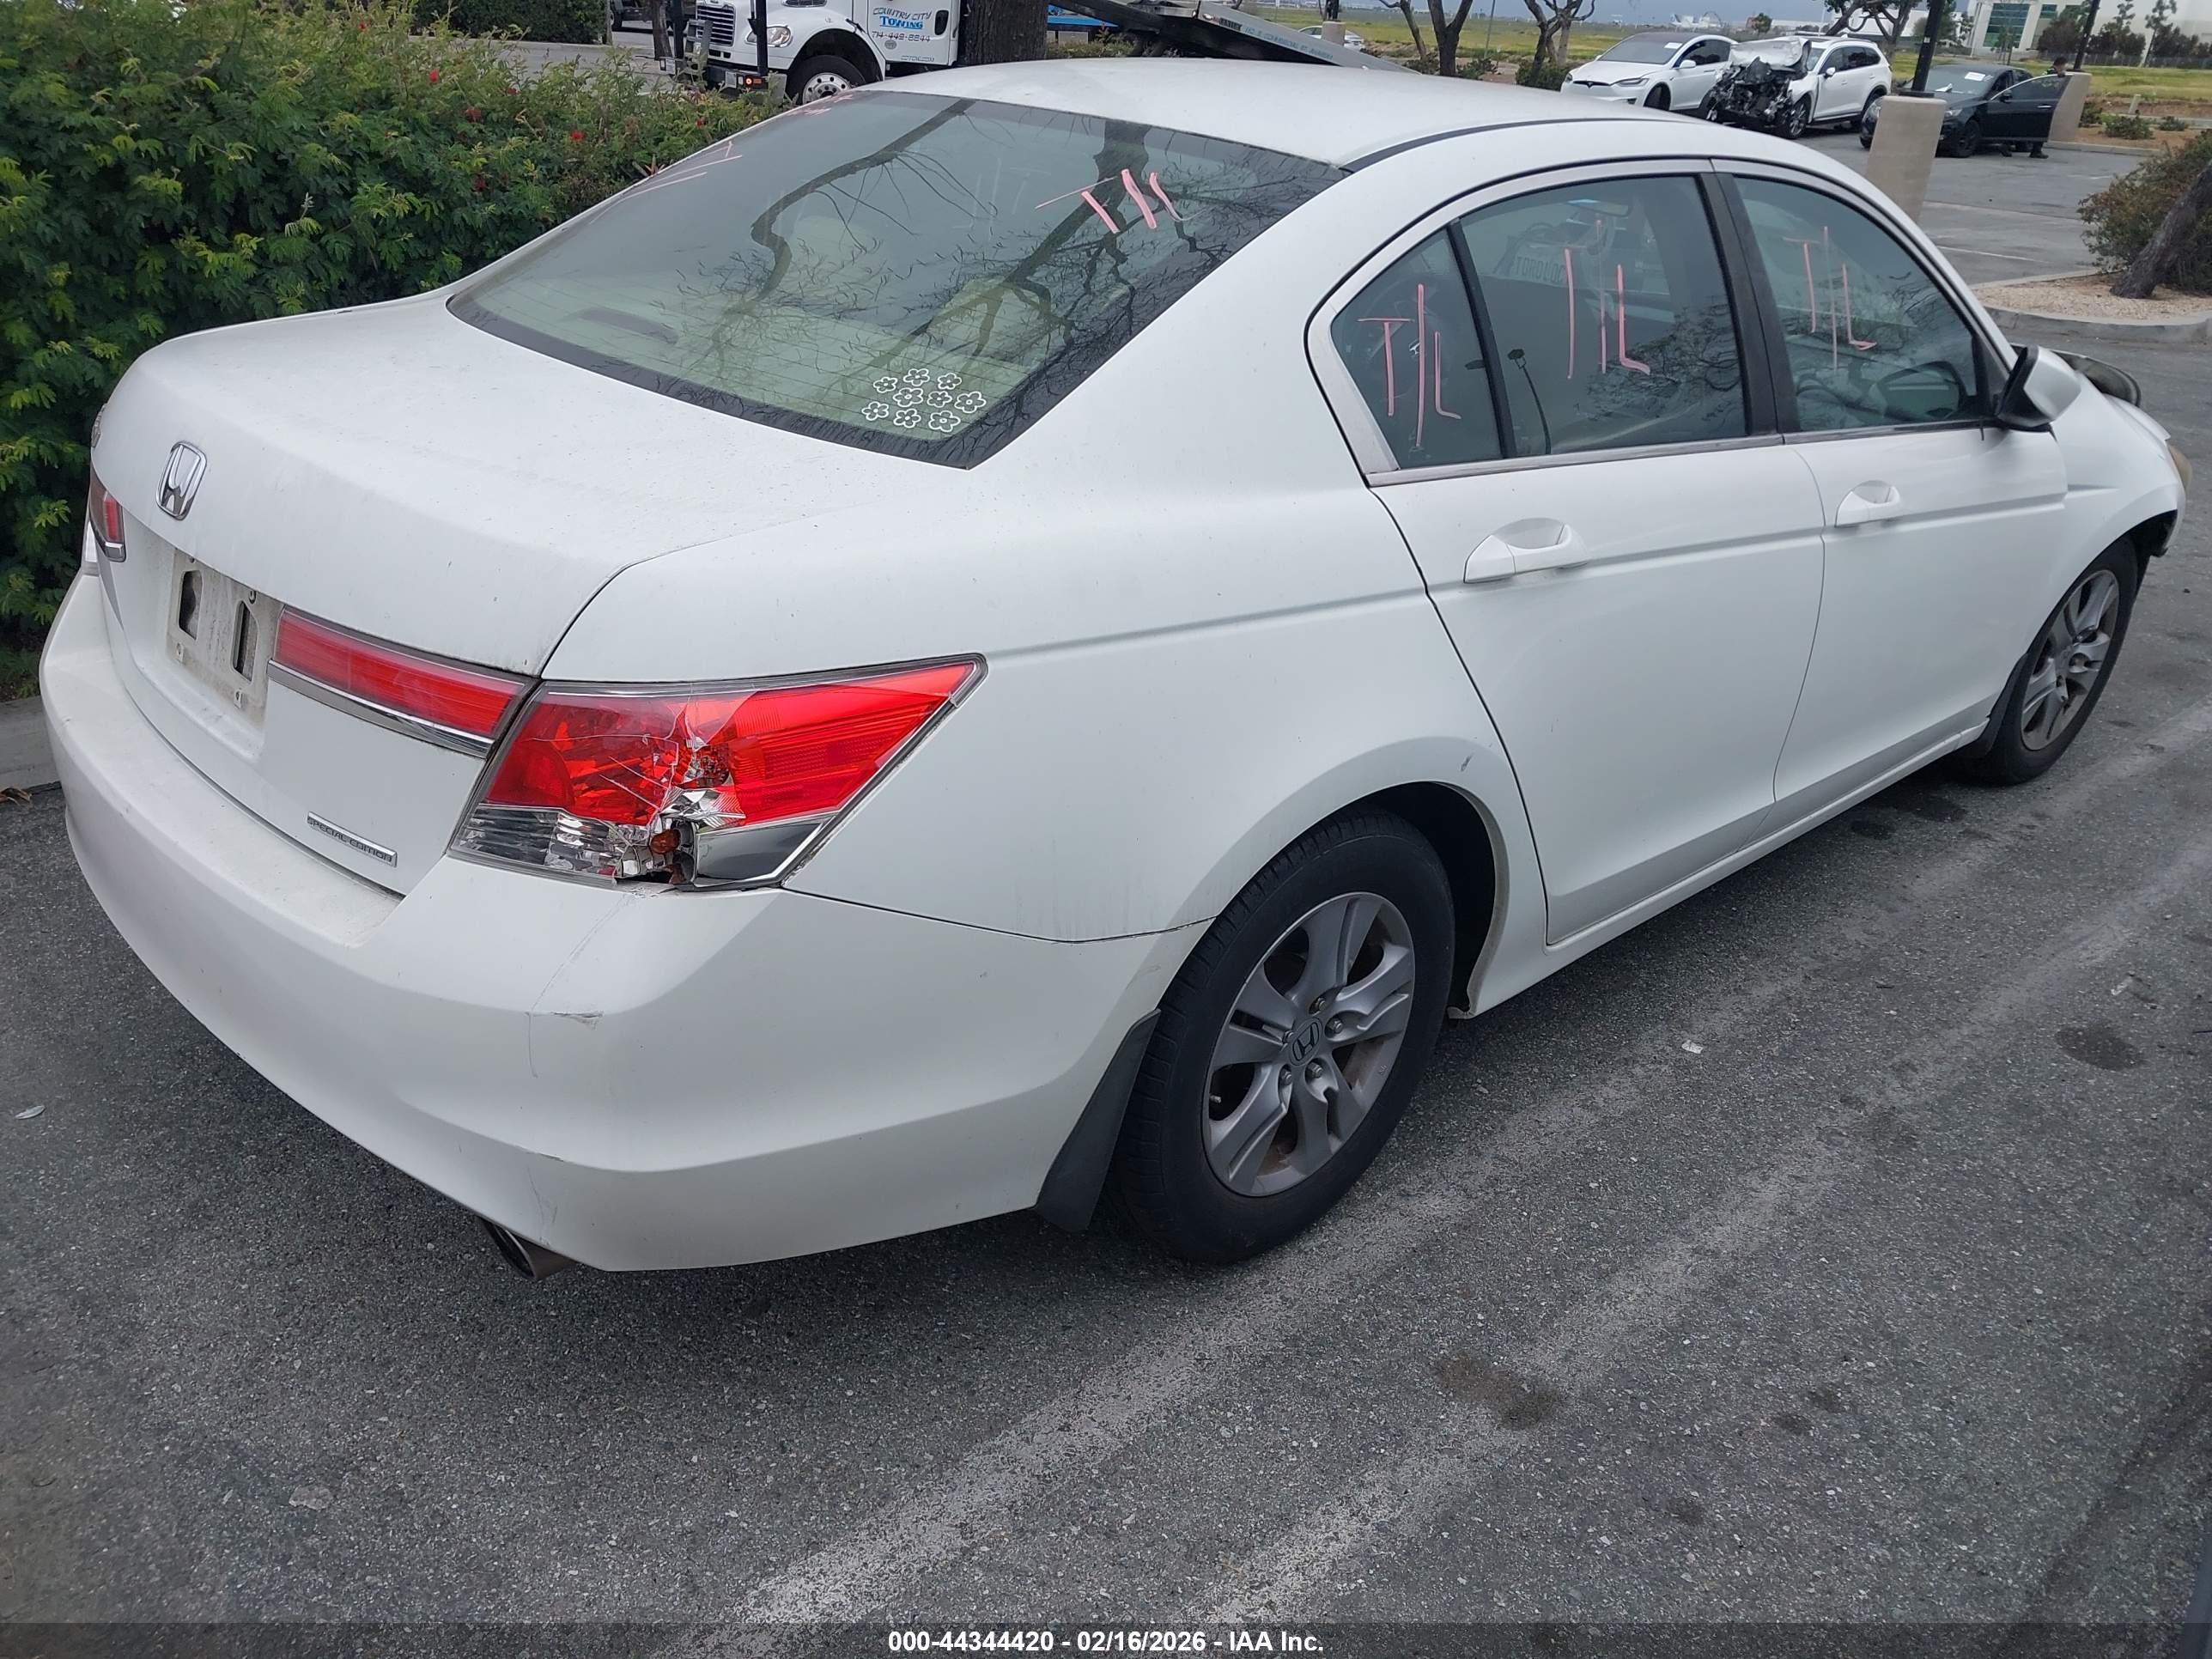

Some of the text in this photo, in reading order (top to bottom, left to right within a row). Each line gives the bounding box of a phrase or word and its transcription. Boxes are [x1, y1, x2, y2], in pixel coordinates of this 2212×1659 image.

[879, 15, 923, 29] TOWING
[911, 11, 933, 21] CITY
[307, 817, 347, 843] SPECIAL
